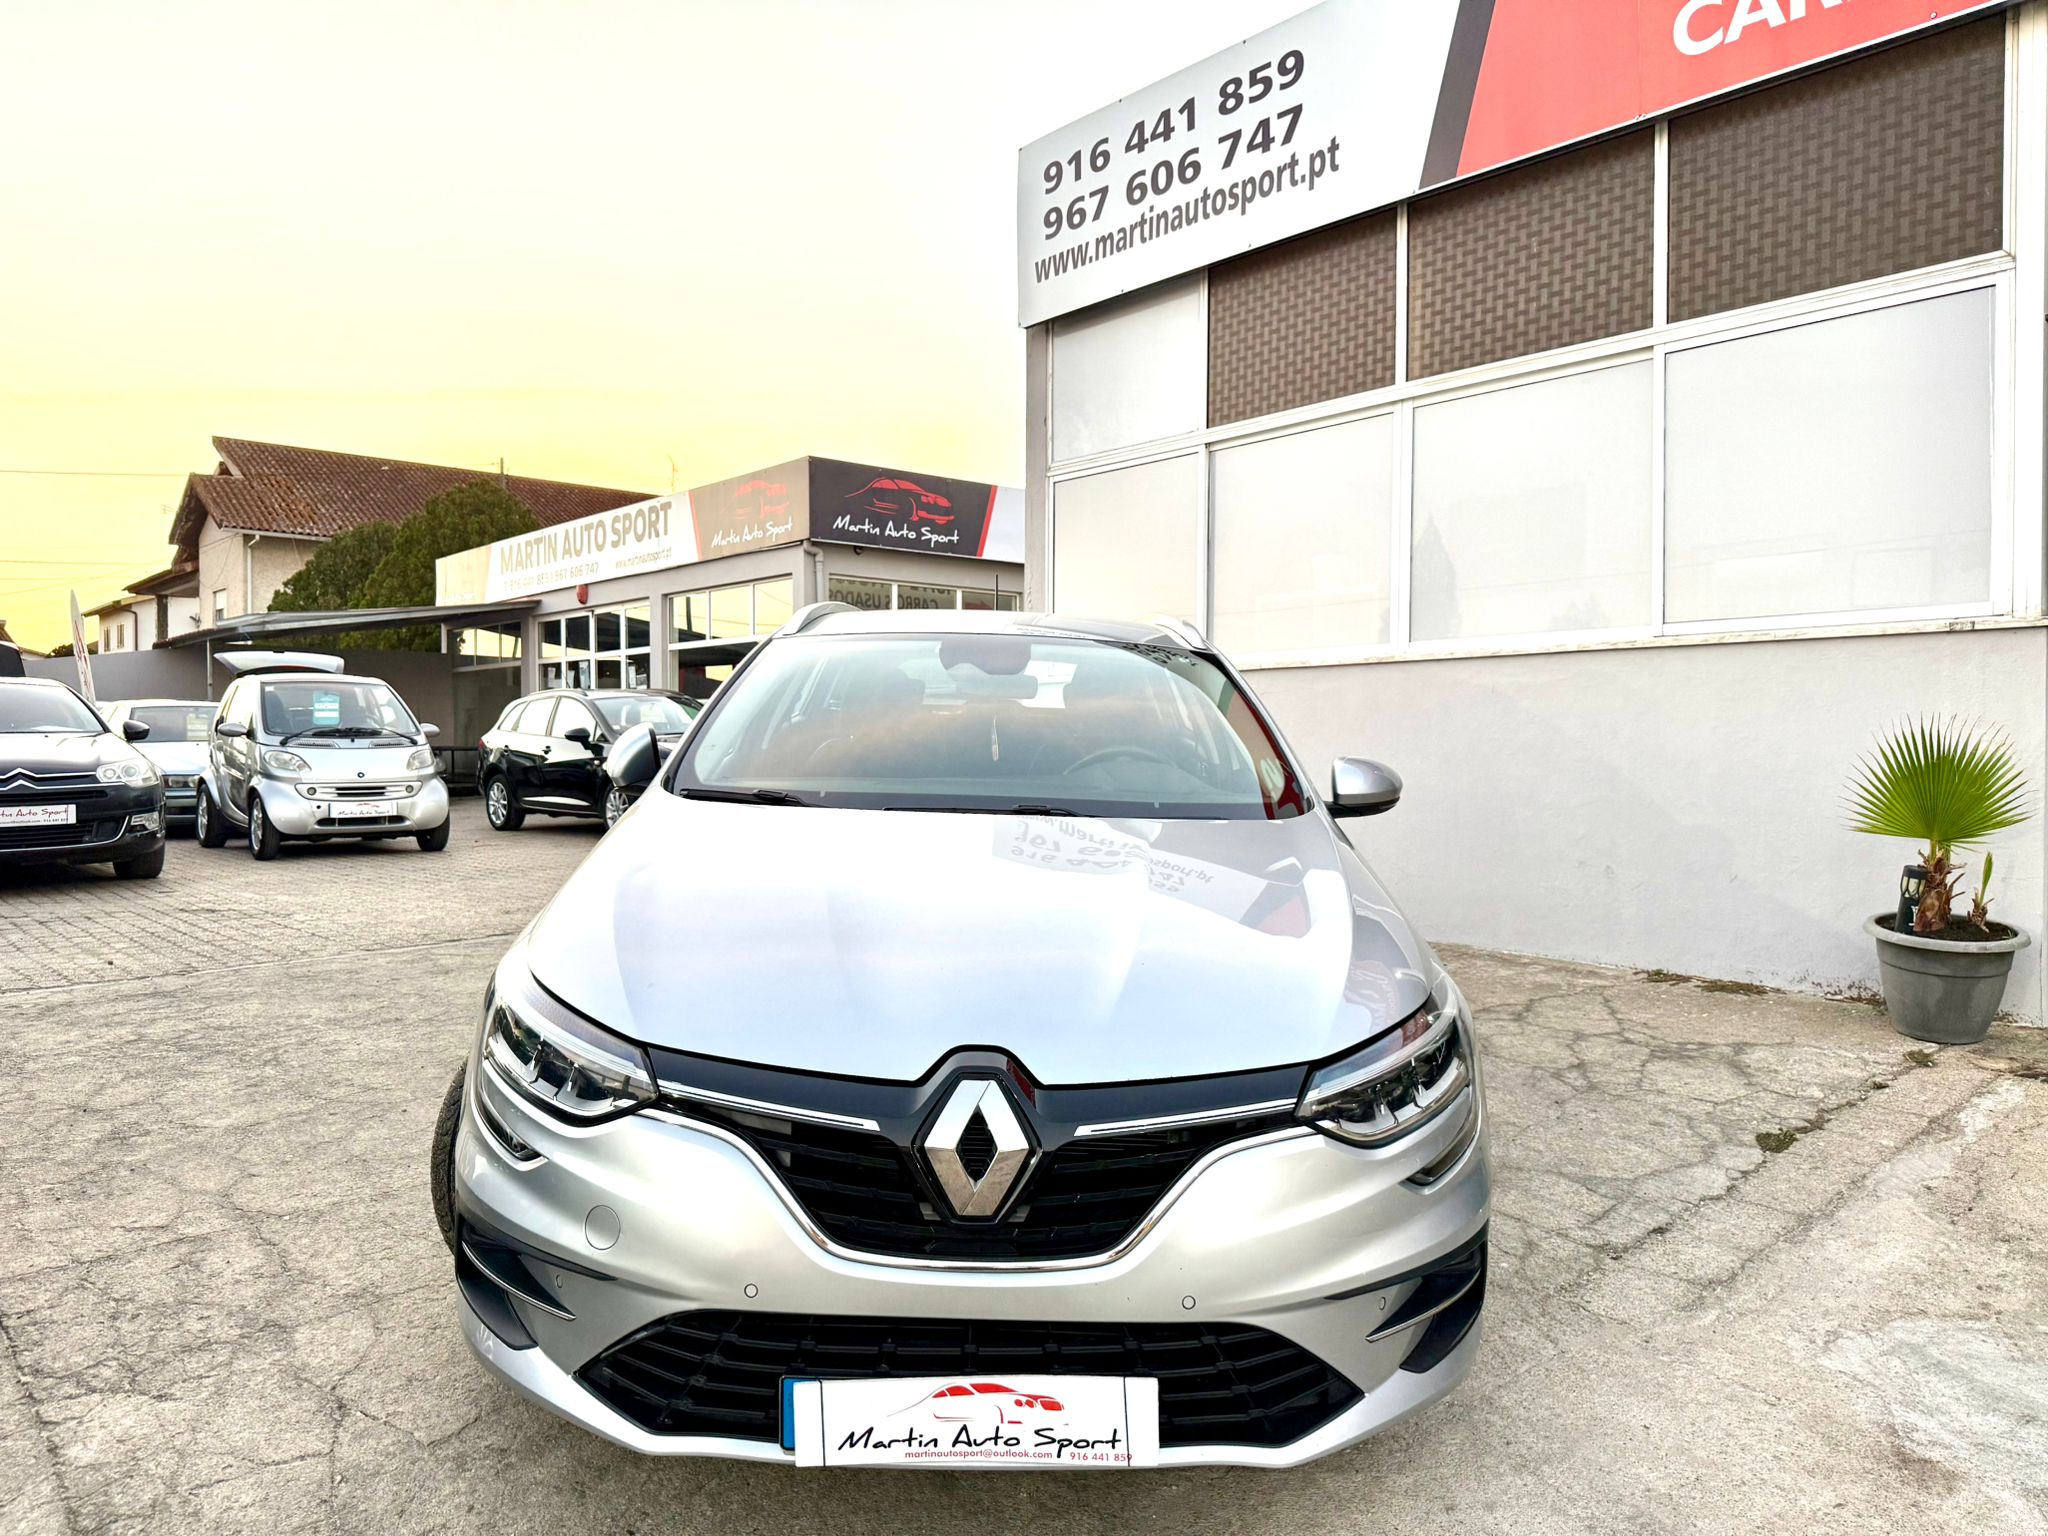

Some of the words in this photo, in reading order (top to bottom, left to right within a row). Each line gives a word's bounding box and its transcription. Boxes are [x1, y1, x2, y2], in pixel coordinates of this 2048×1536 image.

[1043, 137, 1111, 195] 916
[1124, 96, 1196, 154] 441
[1218, 49, 1305, 116] 859
[1043, 185, 1110, 241] 967
[1125, 147, 1201, 206] 606
[1217, 103, 1304, 170] 747
[1034, 135, 1340, 284] www.martinautosport.pt
[500, 532, 558, 575] MARTIN
[561, 519, 607, 561] AUTO
[610, 501, 672, 549] SPORT
[711, 528, 741, 548] Martin
[742, 523, 764, 542] Auto
[765, 515, 793, 542] Sport
[832, 514, 881, 536] Martin
[884, 520, 917, 540] Auto
[920, 526, 960, 548] Sport
[570, 563, 583, 577] 606
[585, 561, 599, 575] 747
[16, 808, 38, 818] Auto
[41, 807, 67, 818] Sport
[838, 1426, 939, 1451] Martin
[951, 1423, 1021, 1448] Auto
[1033, 1427, 1122, 1459] Sport
[904, 1448, 1053, 1460] martinautosport@outlook.com
[1069, 1452, 1089, 1461] 916
[1091, 1452, 1110, 1462] 441
[1113, 1453, 1133, 1462] 859
